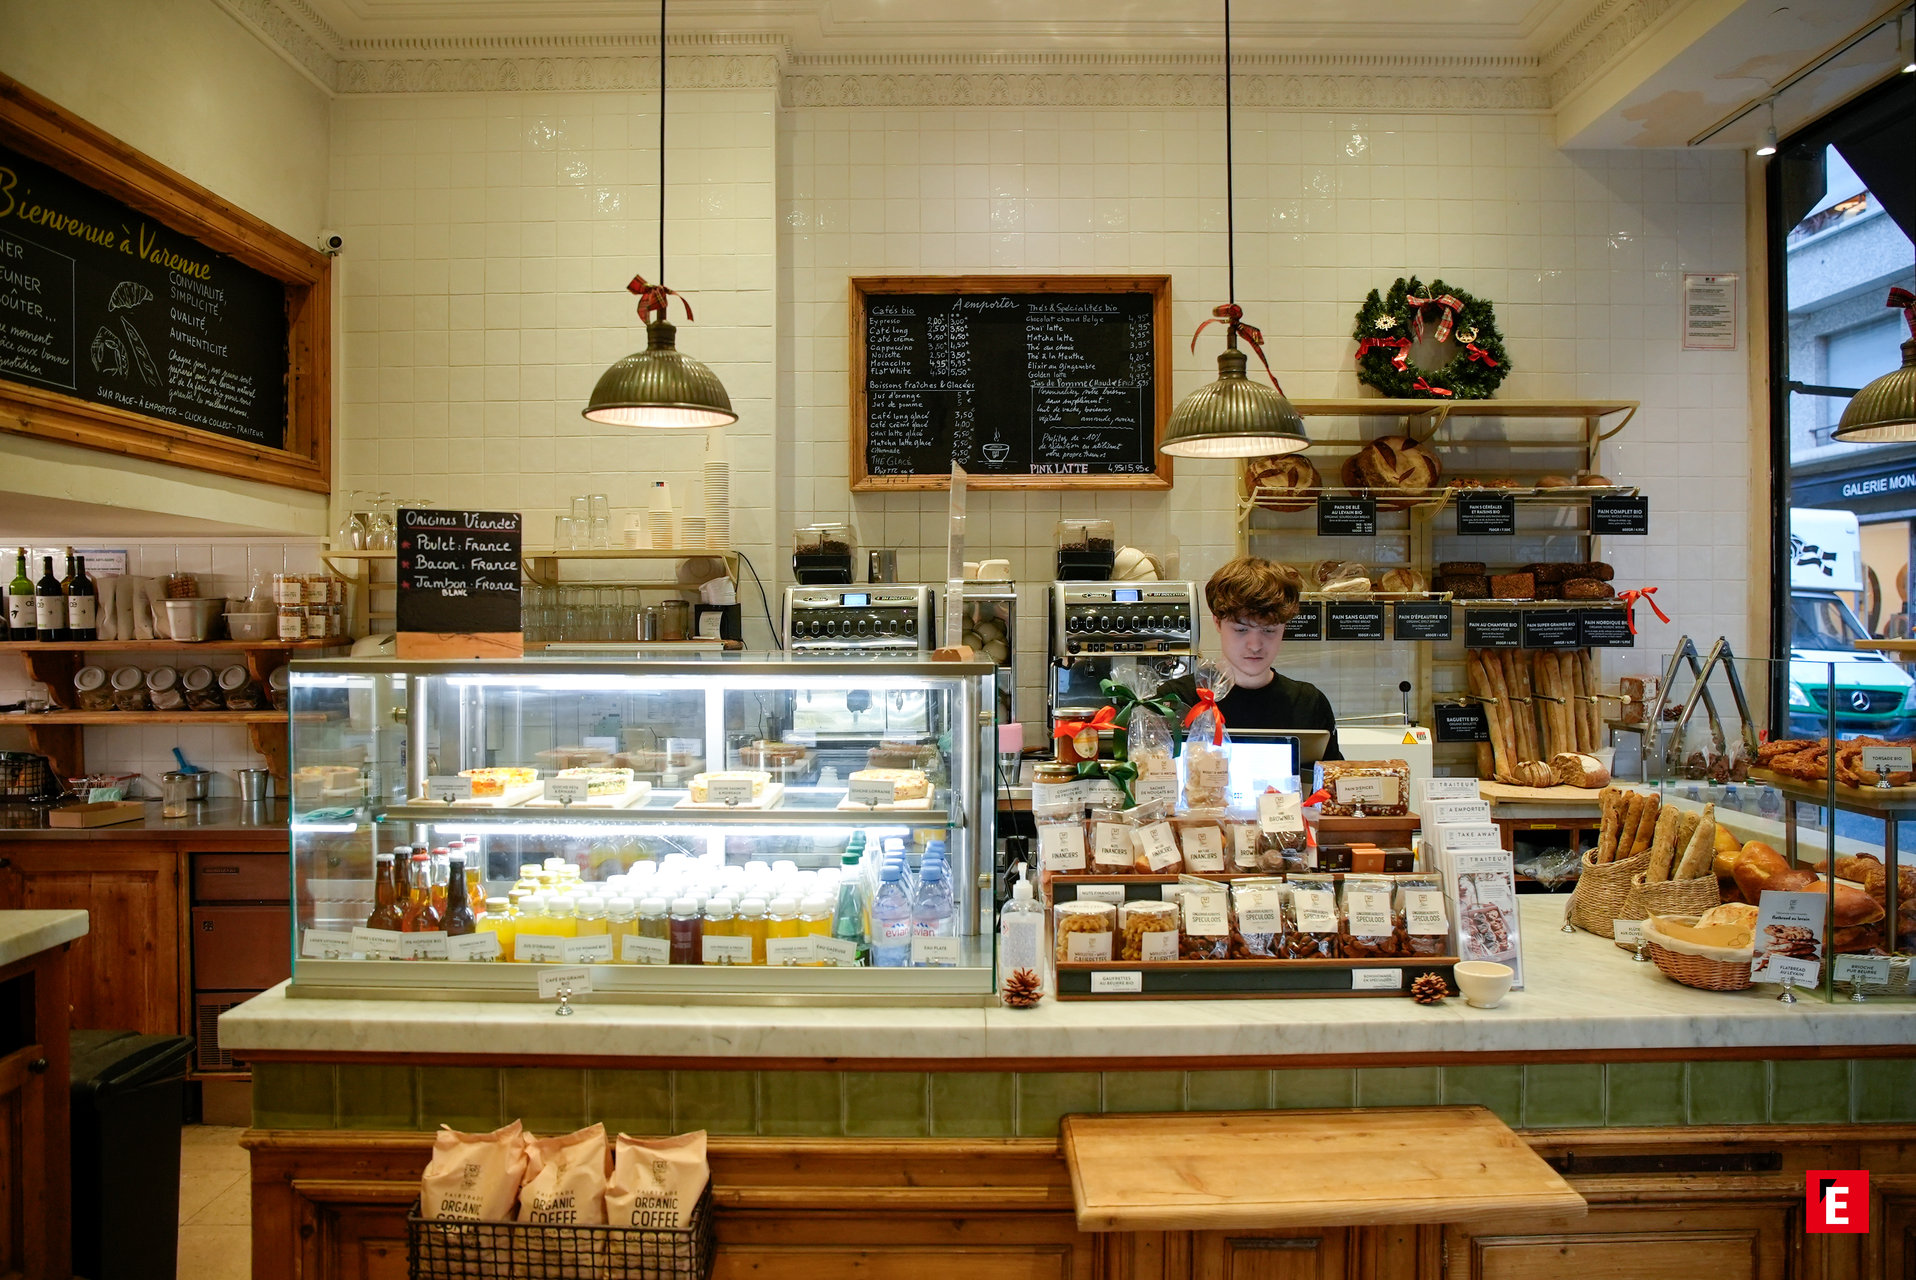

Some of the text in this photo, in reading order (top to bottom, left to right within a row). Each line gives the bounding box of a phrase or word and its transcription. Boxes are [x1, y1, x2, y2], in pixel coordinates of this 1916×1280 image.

[0, 166, 211, 280] Bienvenue à Varenne
[0, 288, 56, 322] OÛTER...
[872, 305, 915, 315] Cafés bio
[964, 297, 1020, 313] emporter
[1056, 303, 1102, 313] Spécialités
[1105, 304, 1118, 312] bio
[870, 327, 890, 335] Café
[1047, 324, 1063, 332] latte
[10, 326, 54, 346] moment
[1027, 334, 1054, 342] Matcha
[169, 327, 228, 358] AUTHENTICITÉ
[17, 344, 70, 366] aux bonnes
[870, 345, 912, 354] Cappuccino
[870, 380, 902, 389] Boissons
[97, 386, 114, 400] SUR
[114, 392, 135, 405] PLACE
[144, 400, 177, 416] EMPORTER
[184, 410, 201, 423] CLICK
[236, 423, 264, 439] TRAITEUR
[894, 414, 908, 423] long
[1030, 464, 1088, 474] PINK LATTE
[1843, 474, 1916, 496] GALERIE MON
[417, 534, 512, 551] Poulet France
[415, 554, 518, 570] Bacon France
[414, 575, 519, 591] Jambon France
[442, 589, 468, 597] BLANC
[1101, 847, 1128, 855] FINANCIERS
[1245, 913, 1275, 921] SPECULOOS
[1356, 915, 1385, 924] SPECULOOS
[1412, 914, 1441, 922] SPECULOOS
[885, 926, 909, 938] evian
[912, 926, 935, 937] evian
[1779, 965, 1806, 973] FLATBREAD
[441, 1199, 483, 1216] ORGANIC
[532, 1196, 576, 1211] ORGANIC
[634, 1197, 679, 1210] ORGANIC
[631, 1210, 679, 1228] COFFEE
